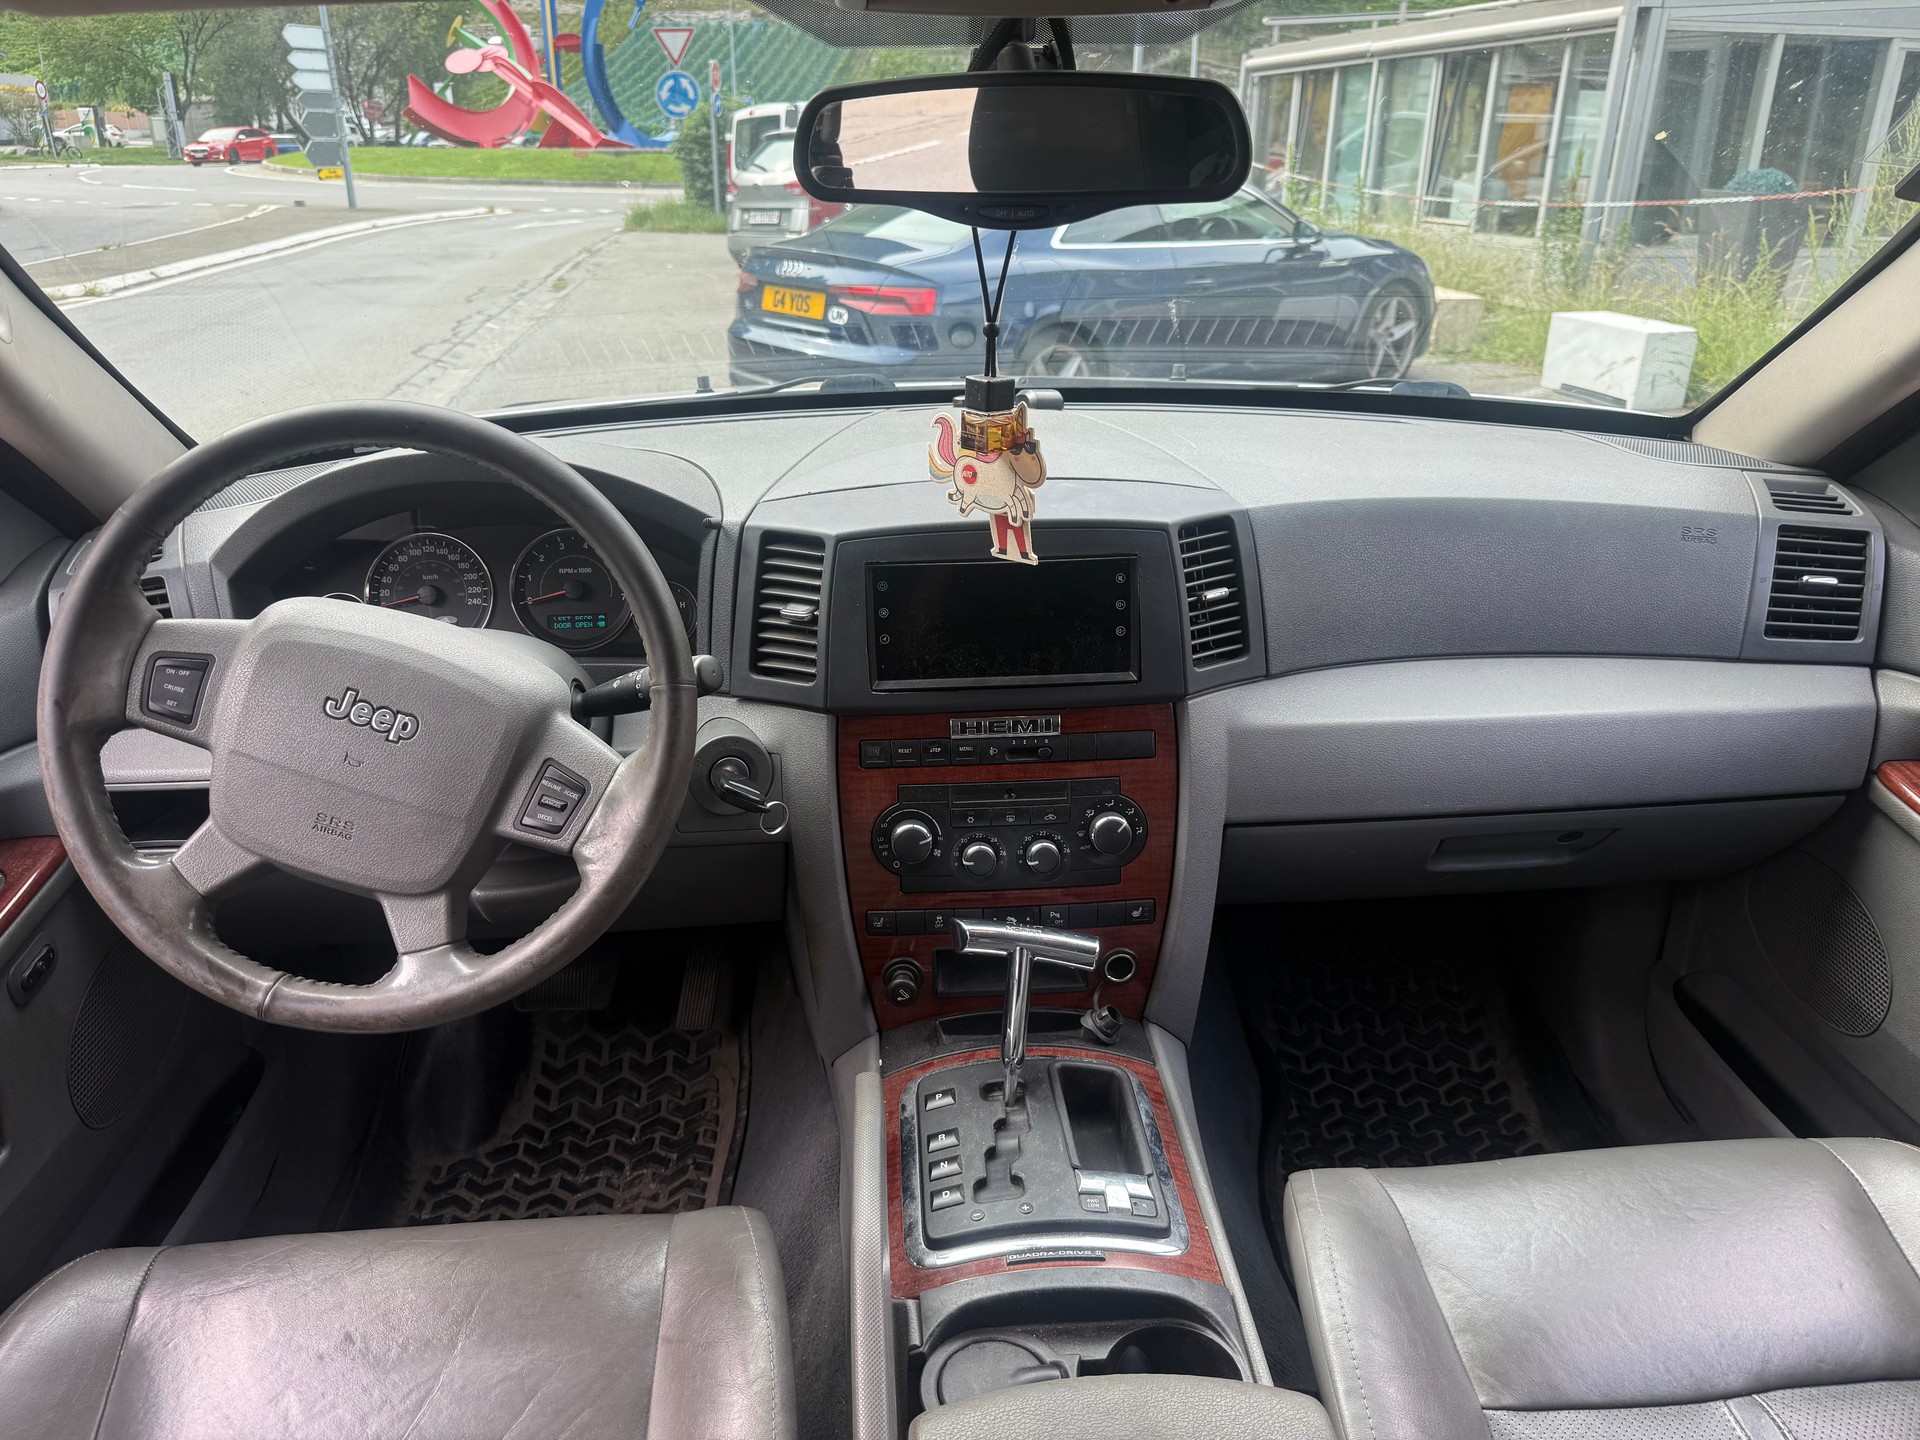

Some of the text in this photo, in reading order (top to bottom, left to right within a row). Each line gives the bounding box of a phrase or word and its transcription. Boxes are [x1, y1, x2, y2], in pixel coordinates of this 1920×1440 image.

[773, 290, 786, 308] G4
[832, 311, 845, 322] UK
[164, 683, 185, 693] CRUISE
[323, 687, 421, 744] Jeep
[959, 718, 1053, 735] HEMI
[541, 780, 579, 800] RESUME ACCEL
[314, 812, 356, 831] SRS
[537, 813, 553, 822] DECEL
[312, 823, 353, 841] AIRBAG
[942, 1191, 950, 1199] D
